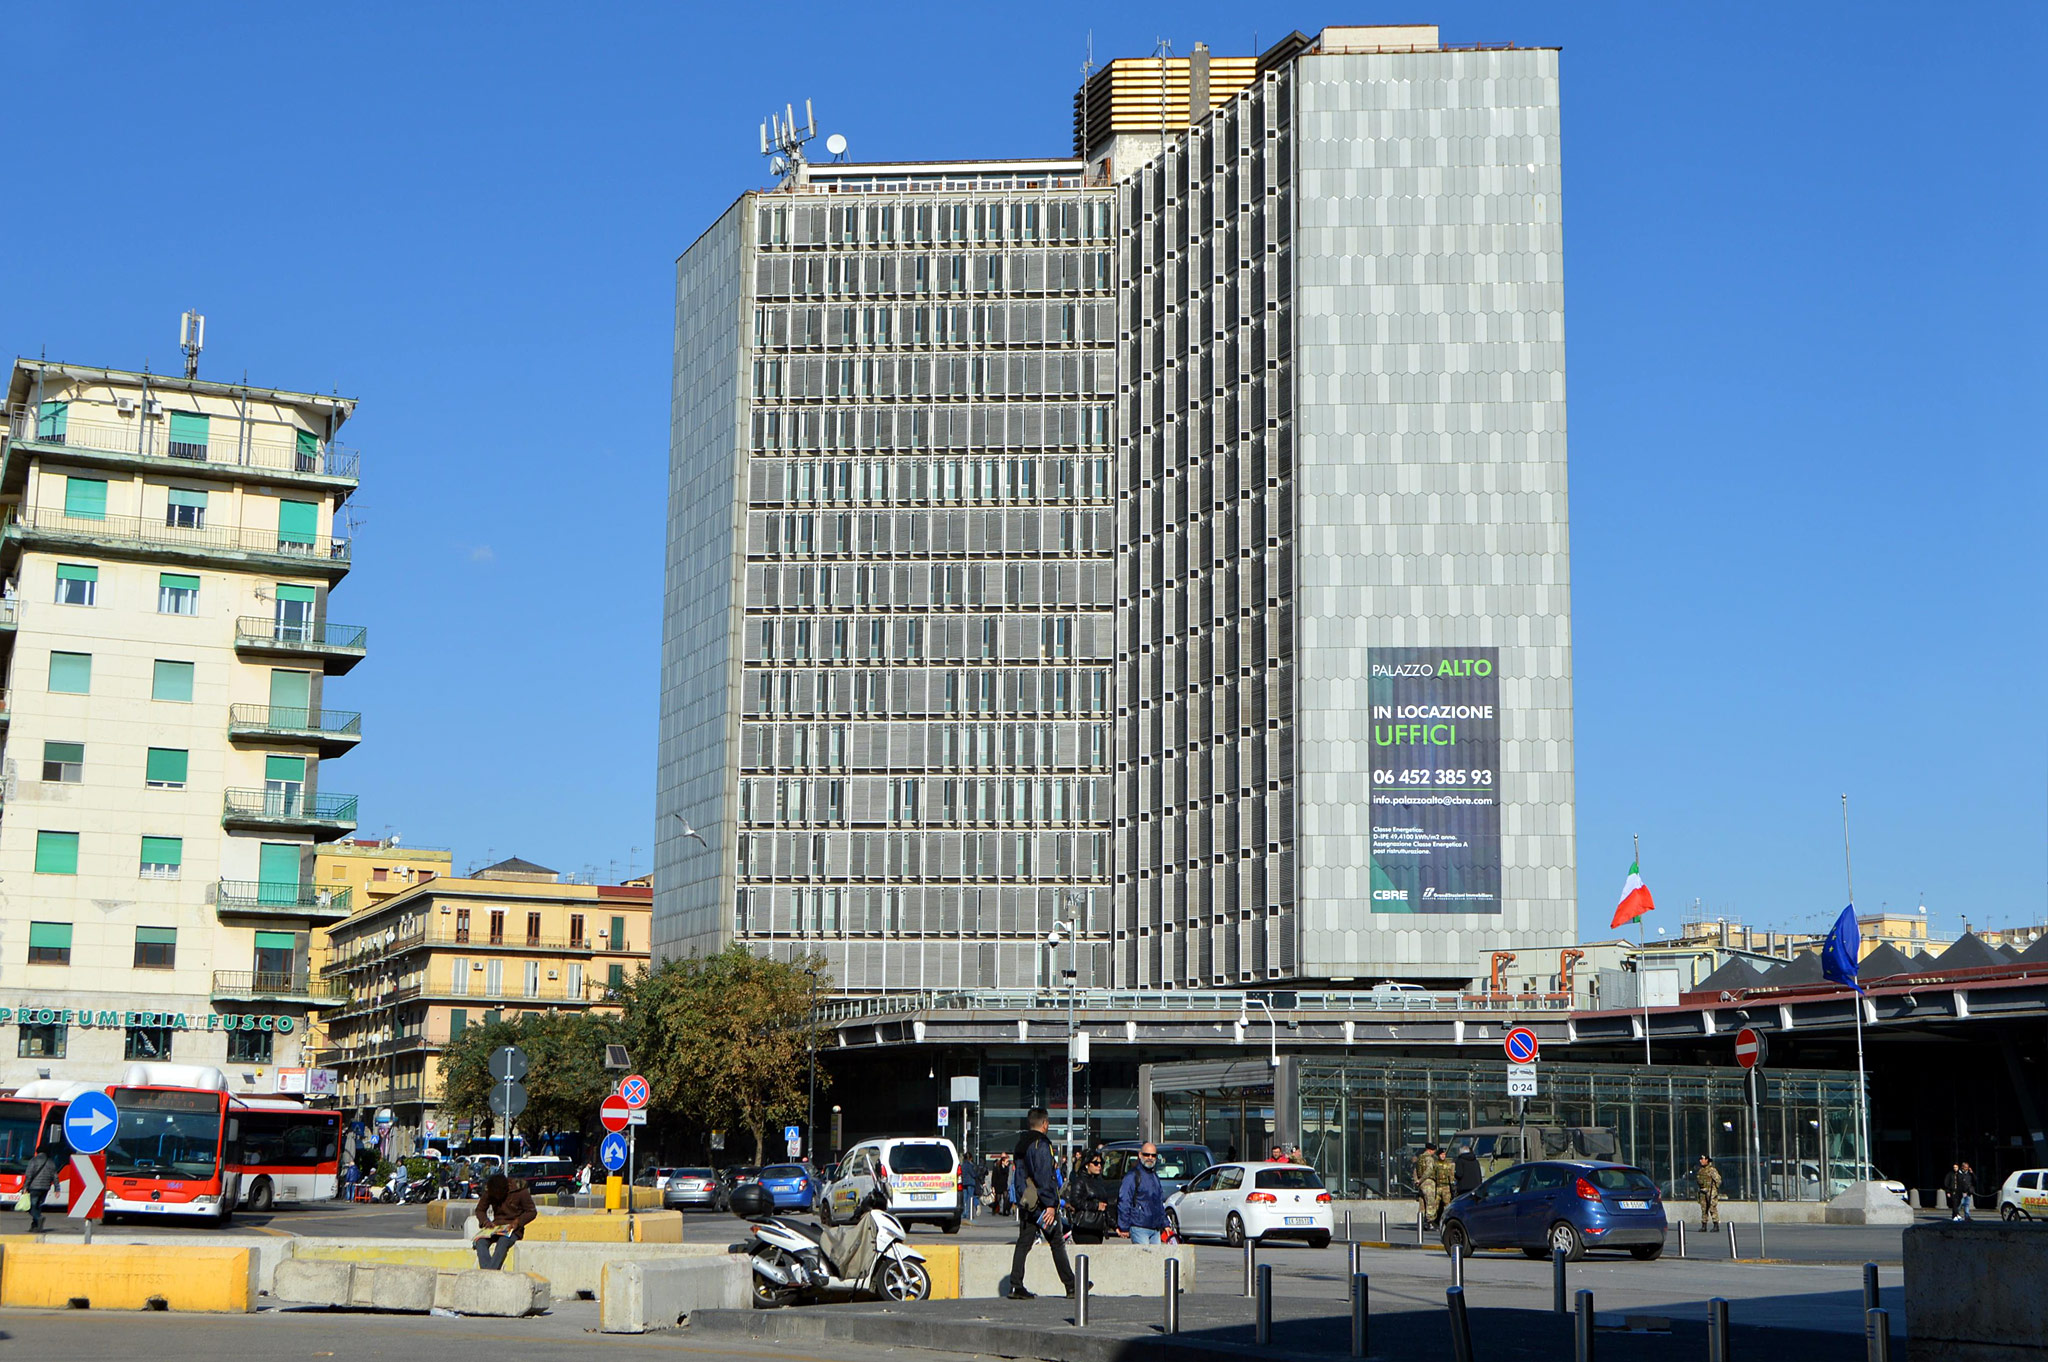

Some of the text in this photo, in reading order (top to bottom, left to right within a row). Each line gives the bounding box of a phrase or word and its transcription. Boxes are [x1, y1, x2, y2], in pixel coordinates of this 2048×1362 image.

[1372, 659, 1493, 677] PALAZZO ALTO
[1373, 704, 1493, 720] IN LOCAZIONE
[1375, 724, 1456, 747] UFFICI
[1373, 769, 1493, 785] 06 452 385 93
[1373, 795, 1493, 806] info.palazzoalto@cbre.com
[1373, 890, 1409, 900] CBRE
[0, 1007, 294, 1032] PROFUMERIA FUSCO
